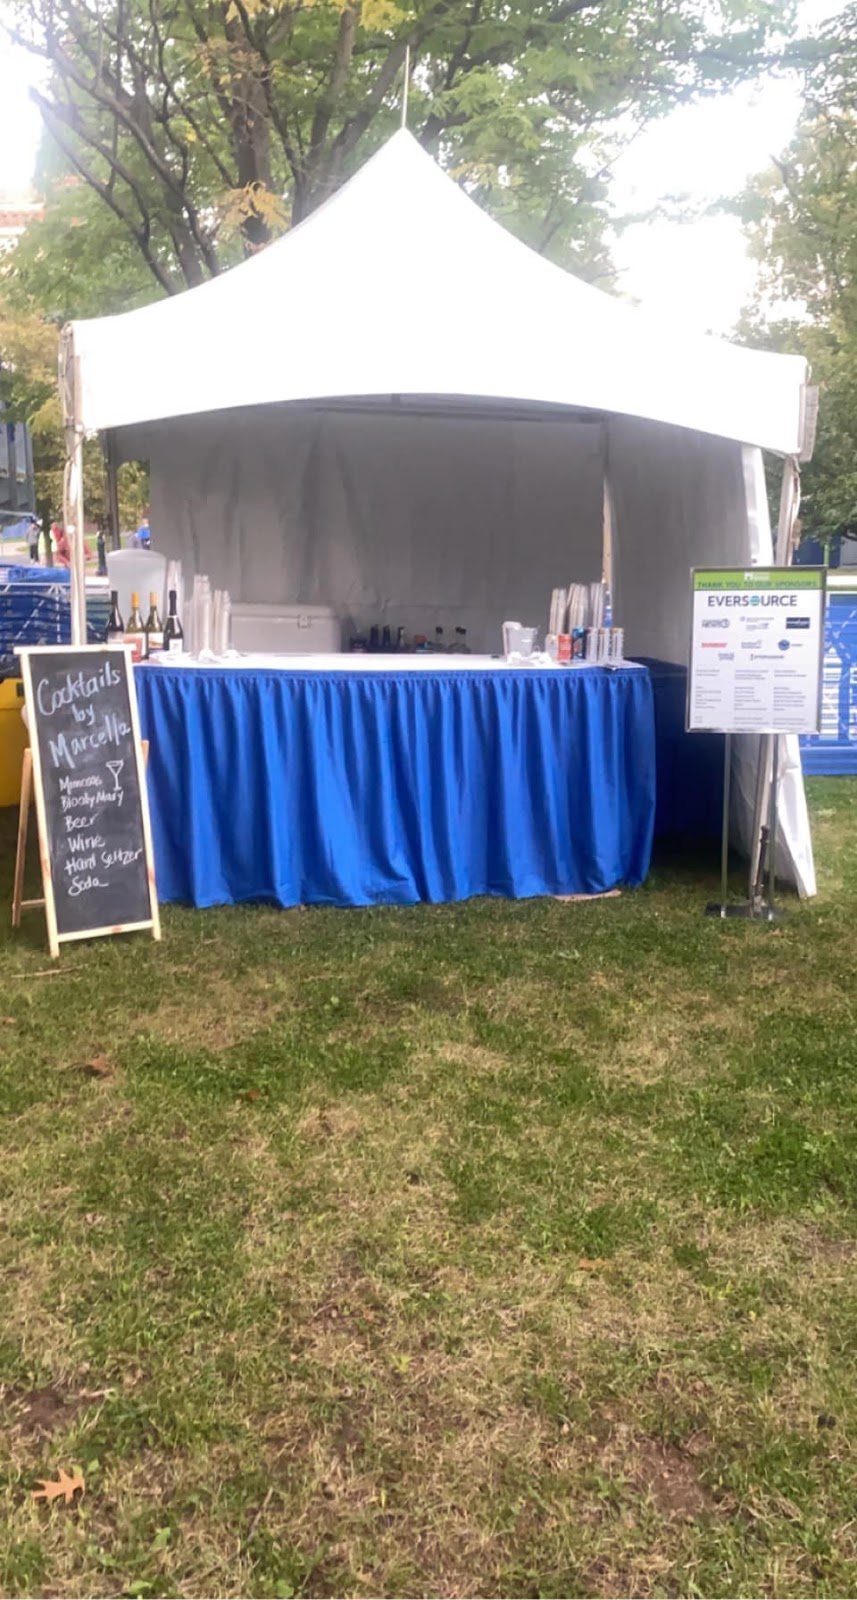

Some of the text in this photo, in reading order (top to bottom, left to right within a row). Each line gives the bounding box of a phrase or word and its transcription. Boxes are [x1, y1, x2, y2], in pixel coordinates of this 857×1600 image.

[708, 595, 798, 607] EVERSOURCE
[37, 661, 121, 716] Cocktails
[71, 703, 96, 726] by
[49, 713, 131, 769] Marcella
[64, 812, 99, 832] Beer
[67, 833, 106, 853] Wine
[64, 848, 143, 876] Hard Seltzer
[68, 875, 109, 897] Soda
